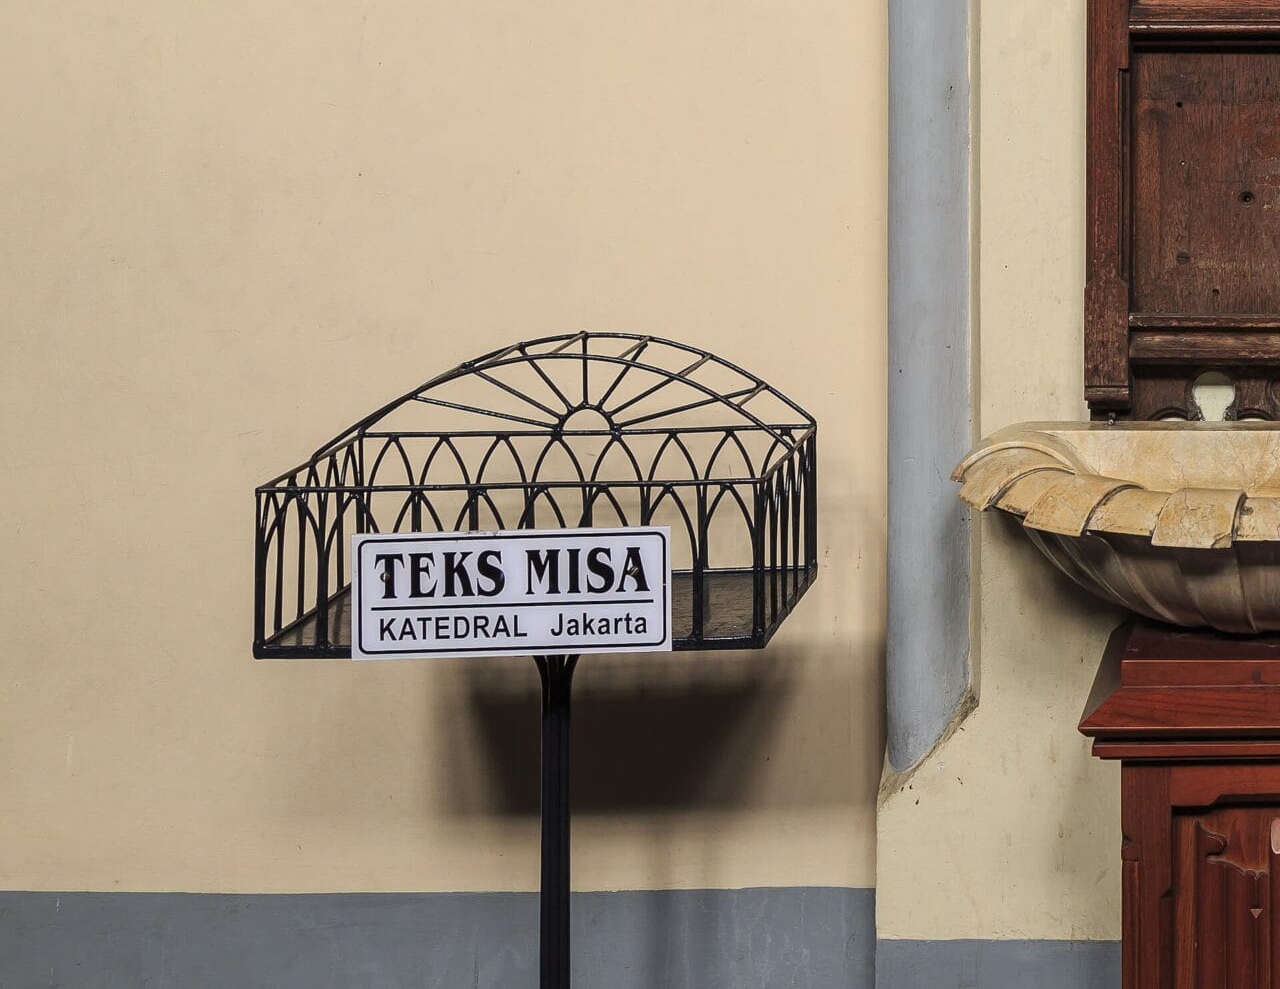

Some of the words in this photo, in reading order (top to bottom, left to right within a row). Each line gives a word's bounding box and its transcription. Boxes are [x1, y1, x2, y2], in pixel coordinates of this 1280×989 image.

[375, 550, 505, 599] TEKS
[525, 547, 651, 595] MISA
[380, 615, 528, 642] KATEDRAL
[551, 613, 648, 637] Jakarta
